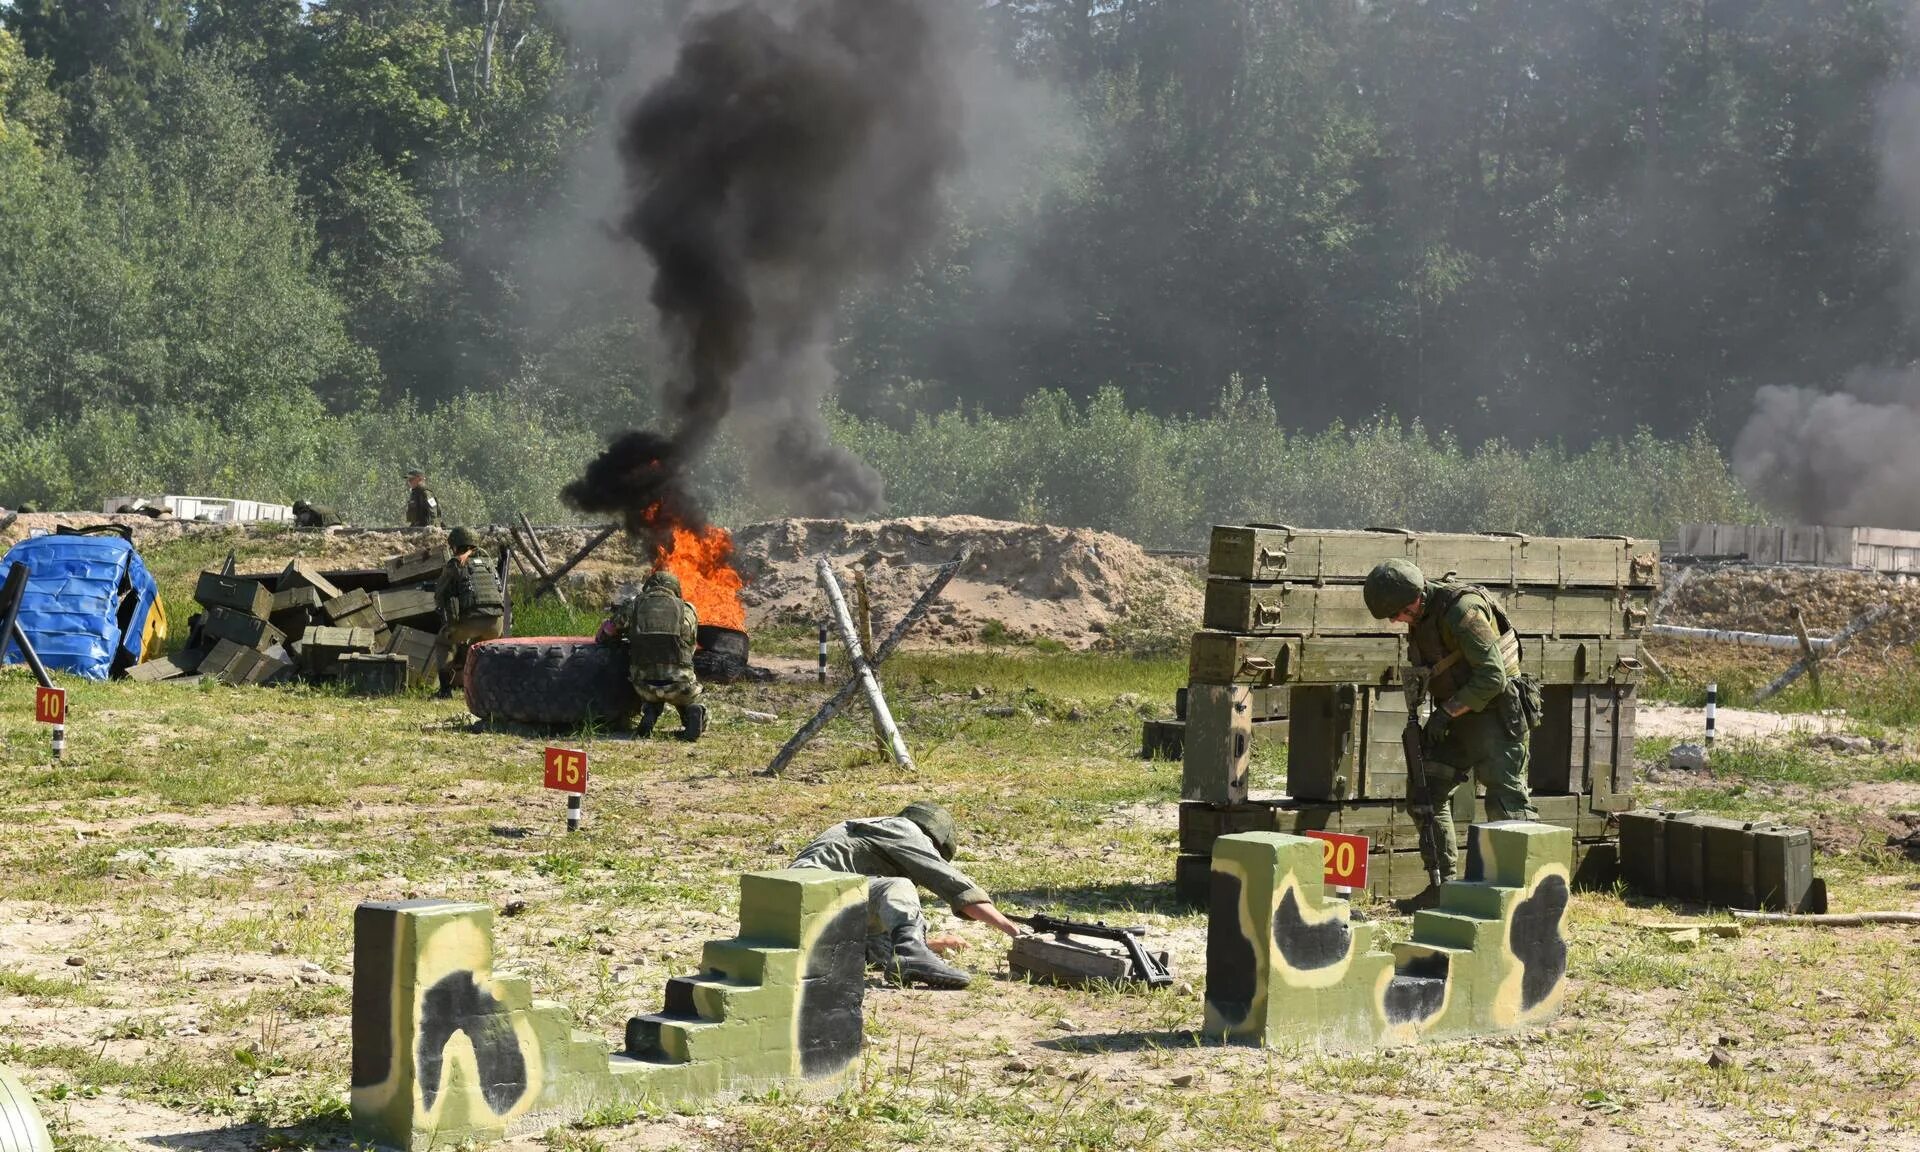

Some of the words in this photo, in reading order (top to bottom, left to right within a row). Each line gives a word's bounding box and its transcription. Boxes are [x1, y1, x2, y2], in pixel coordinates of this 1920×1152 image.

[42, 693, 60, 718] 10
[553, 754, 580, 785] 15
[1323, 839, 1355, 877] 20
